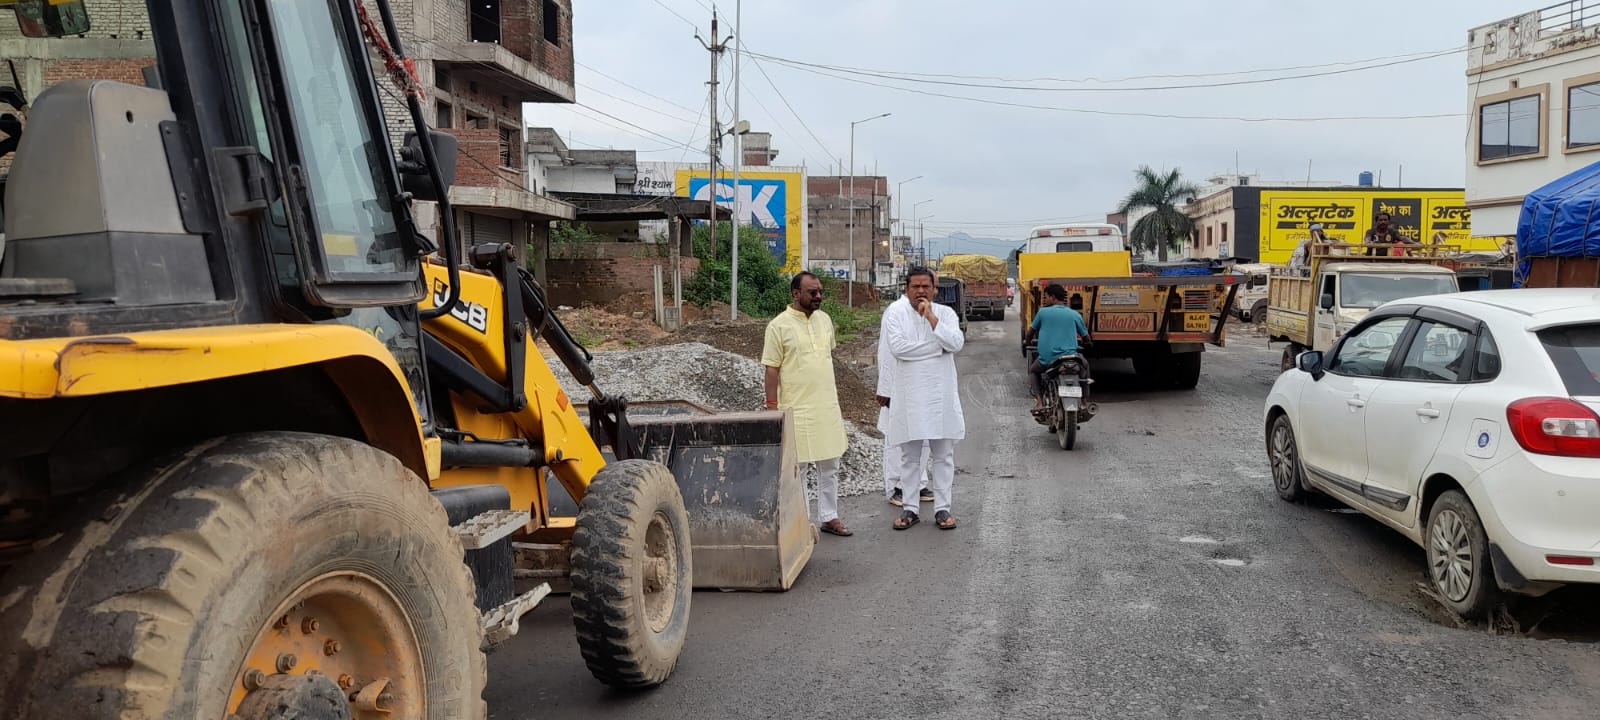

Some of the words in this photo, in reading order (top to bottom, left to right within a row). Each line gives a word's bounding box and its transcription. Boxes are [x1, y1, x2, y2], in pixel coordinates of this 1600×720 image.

[638, 176, 651, 189] श्री
[1277, 203, 1355, 220] अल्ट्राटेक
[1398, 205, 1411, 216] का
[434, 281, 487, 332] JCB
